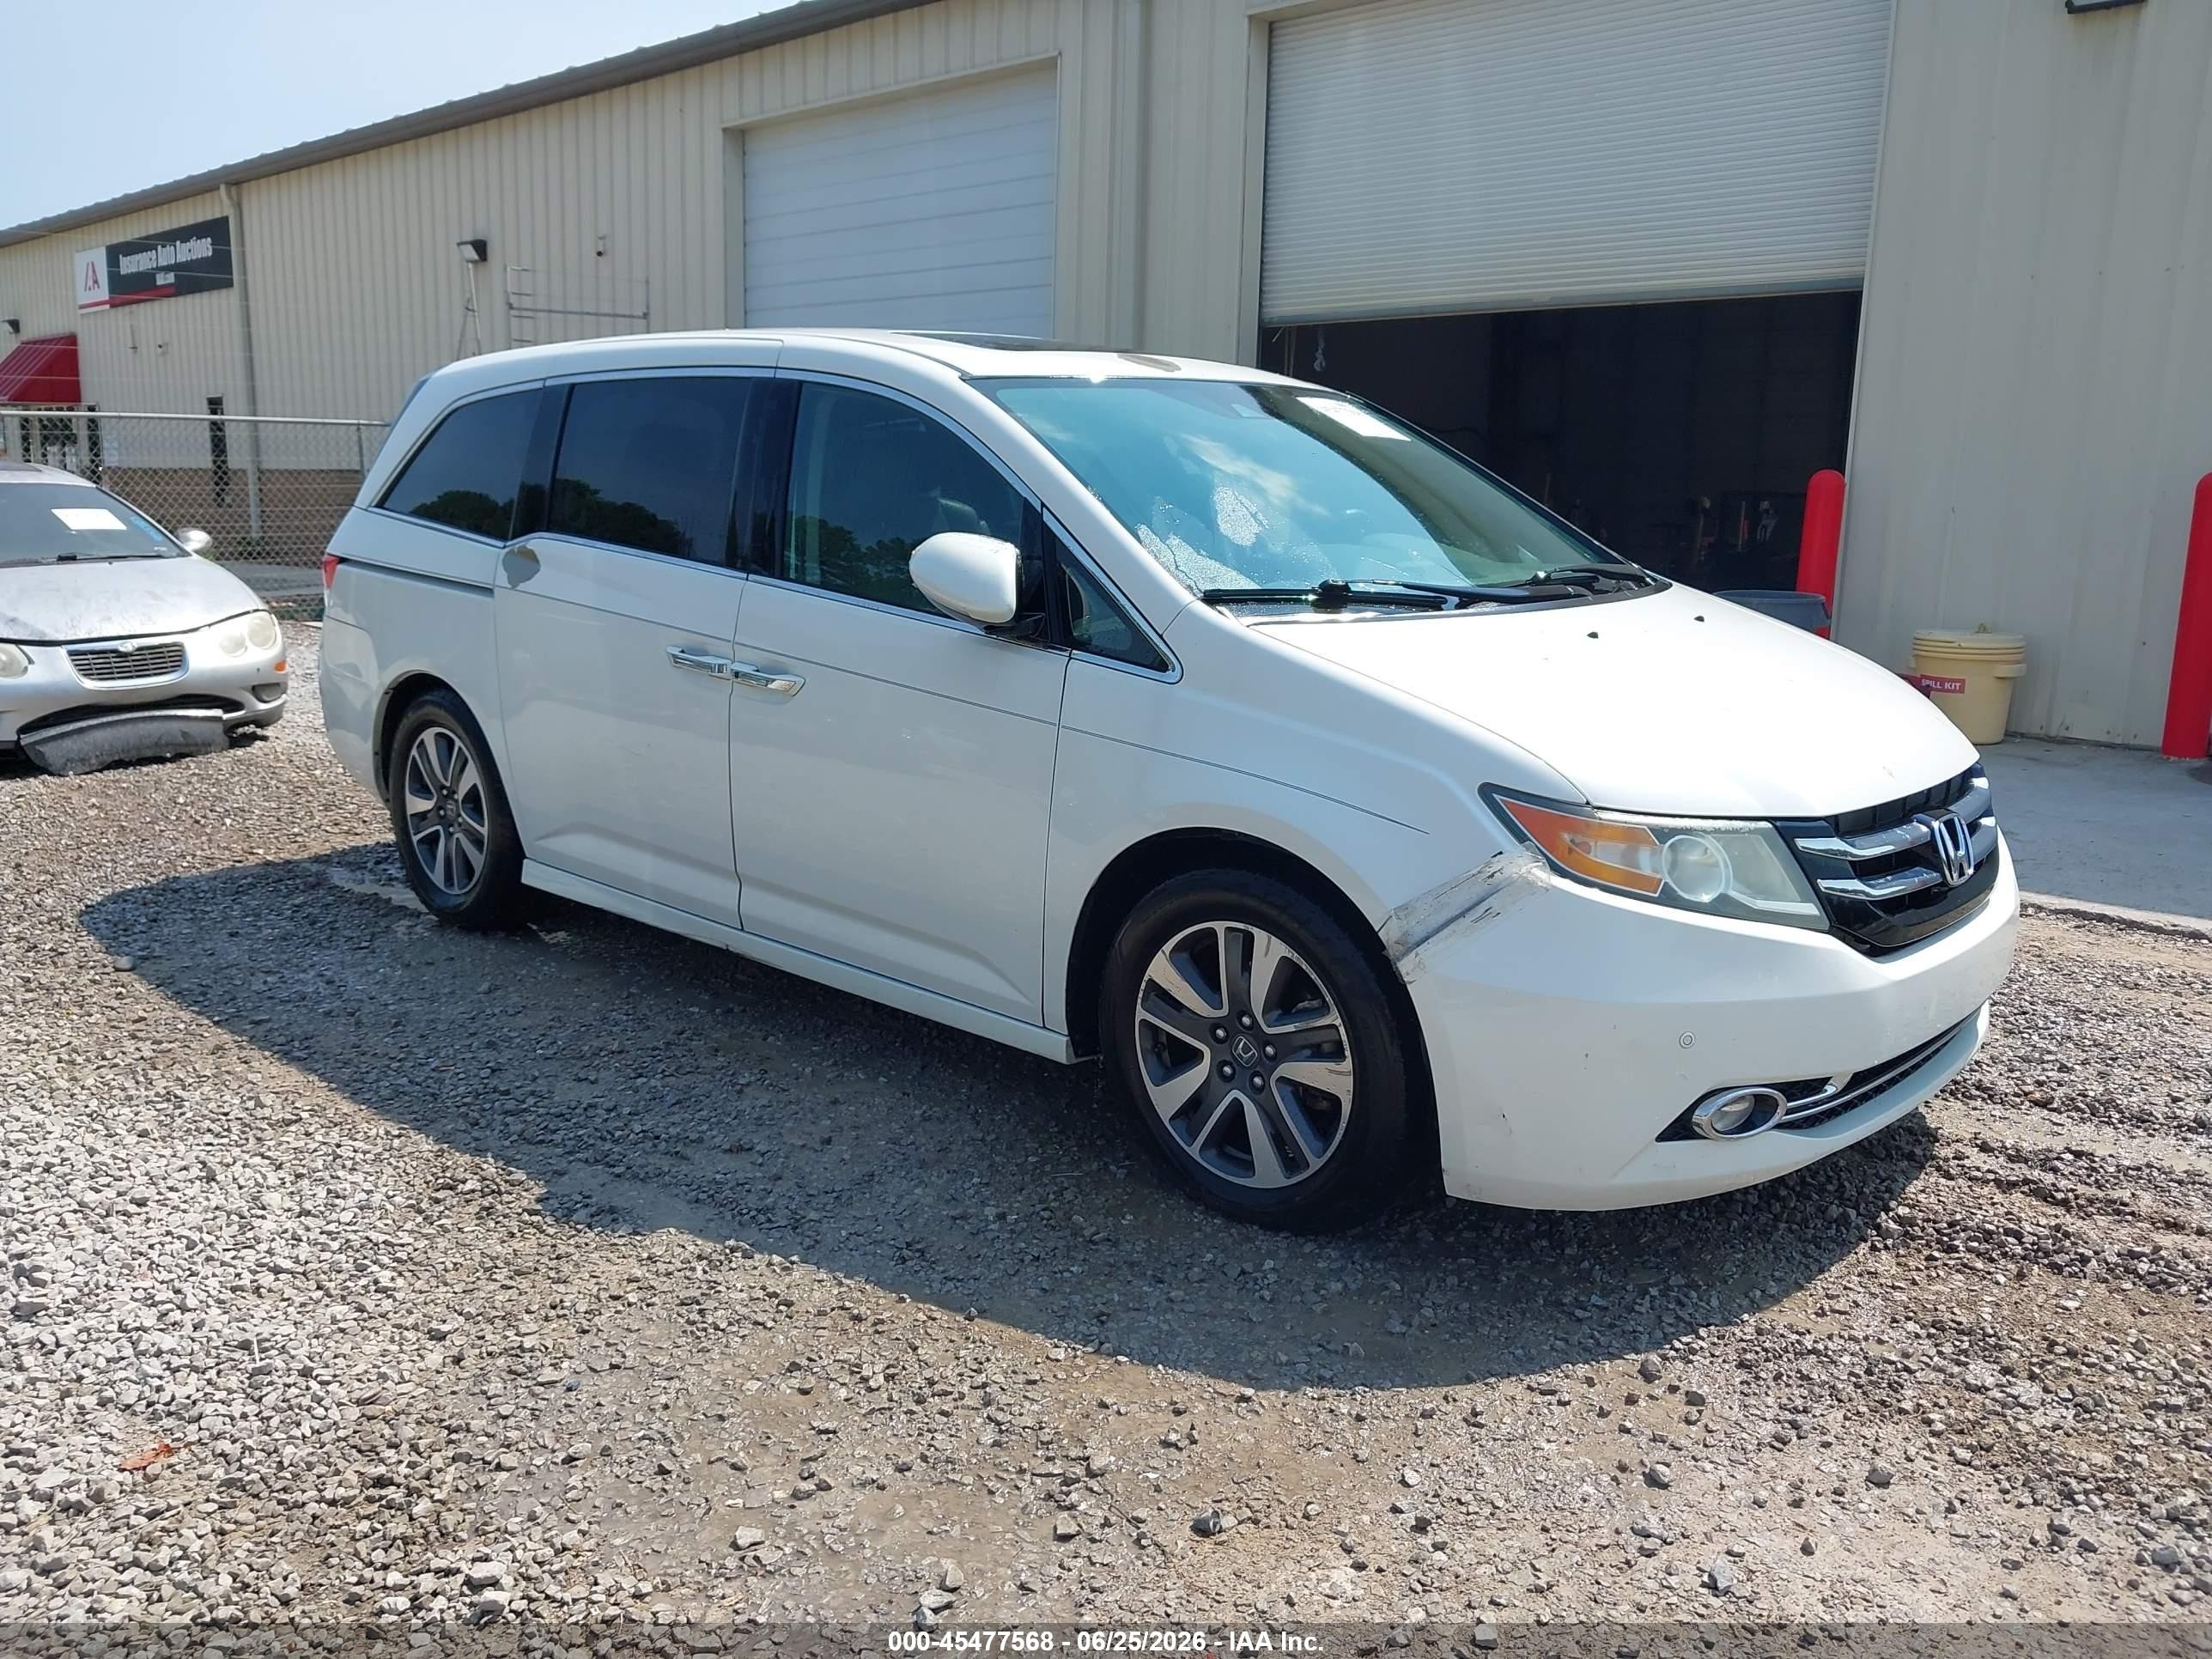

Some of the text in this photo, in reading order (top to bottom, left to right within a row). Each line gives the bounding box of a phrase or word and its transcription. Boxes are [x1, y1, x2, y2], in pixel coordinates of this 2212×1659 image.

[119, 236, 213, 275] Insurance Auto Auctions
[1921, 678, 1962, 690] SPILL KIT
